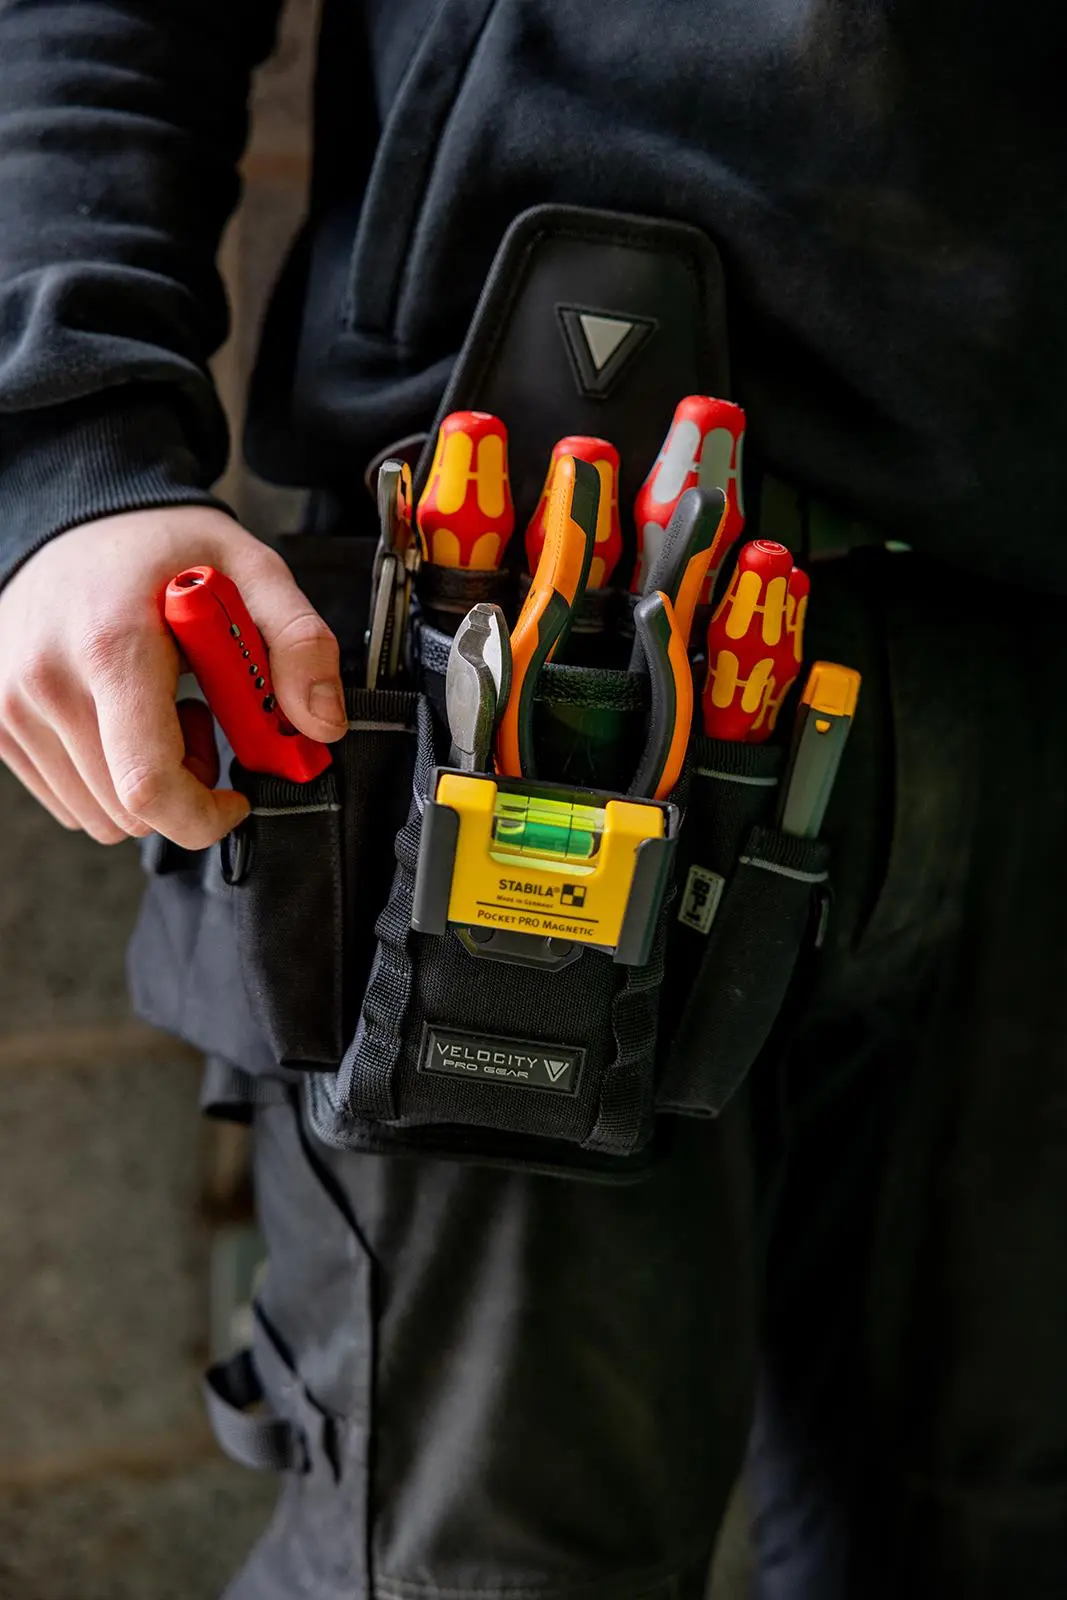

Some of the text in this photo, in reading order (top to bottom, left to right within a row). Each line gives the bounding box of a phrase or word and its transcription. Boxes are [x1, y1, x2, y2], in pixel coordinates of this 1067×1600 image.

[518, 915, 540, 928] PRO
[436, 1043, 538, 1068] VELOCITY
[442, 1059, 529, 1079] PRO GEAR
